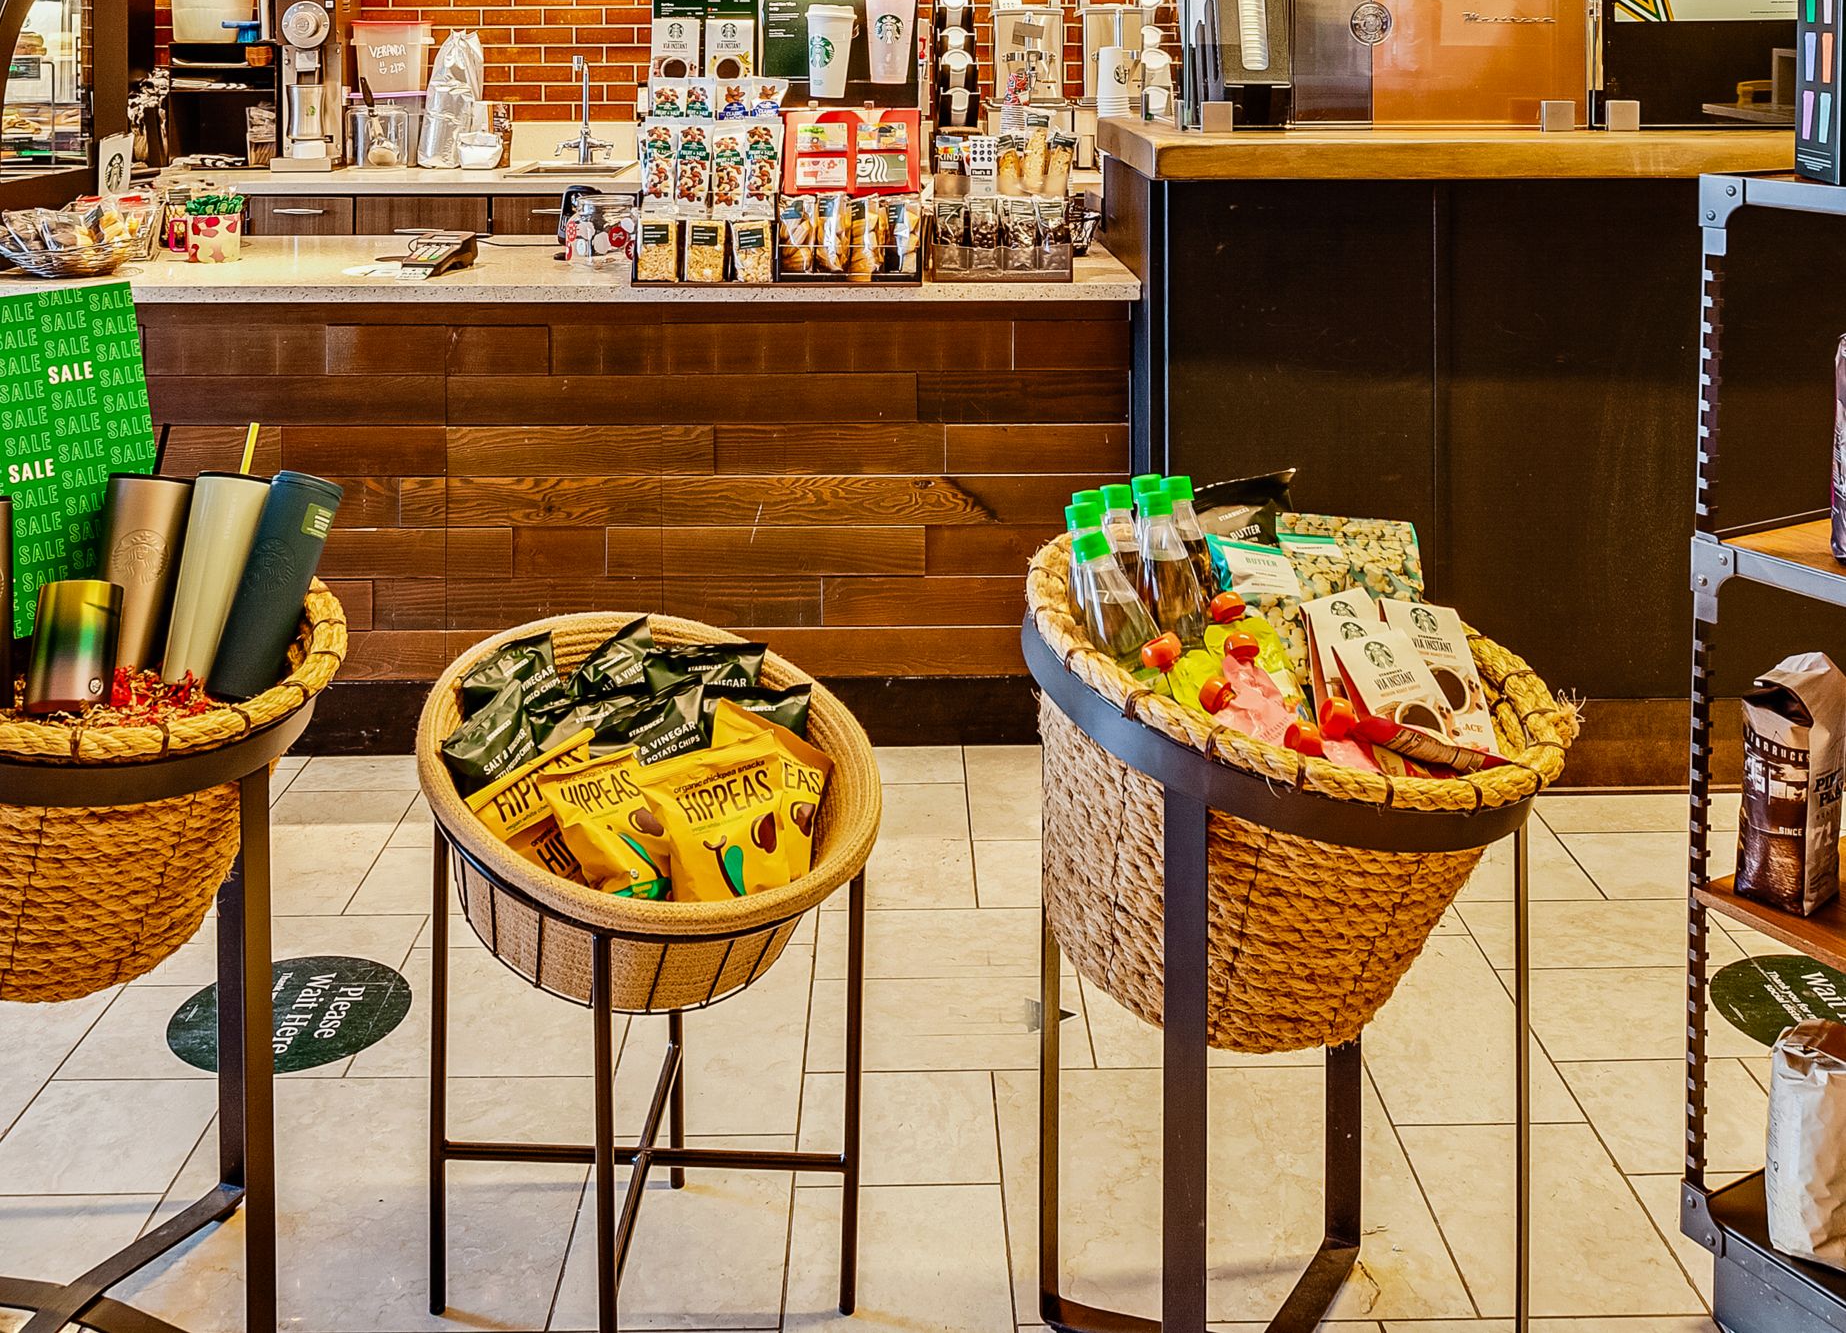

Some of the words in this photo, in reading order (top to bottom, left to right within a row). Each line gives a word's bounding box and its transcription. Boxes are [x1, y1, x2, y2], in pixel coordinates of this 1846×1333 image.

[368, 44, 407, 59] VERANDA
[38, 288, 83, 307] SALE
[89, 289, 134, 312] SALE
[0, 302, 35, 324] ALE
[41, 310, 87, 333] SALE
[92, 313, 138, 337] SALE
[44, 336, 90, 359] SALE
[96, 338, 142, 362] SALE
[48, 361, 94, 384] SALE
[99, 364, 145, 388] SALE
[0, 380, 45, 404] SALE
[51, 387, 98, 411] SALE
[103, 389, 149, 413] SALE
[2, 406, 48, 430] SALE
[54, 412, 101, 437] SALE
[107, 414, 153, 439] SALE
[5, 432, 52, 457] SALE
[58, 438, 105, 463] SALE
[110, 440, 156, 465] SALE
[8, 458, 56, 484] SALE
[62, 464, 109, 489] SALE
[12, 485, 59, 511] SALE
[15, 511, 63, 538] SALE
[1229, 524, 1262, 541] BUTTER
[19, 538, 66, 565] SALE
[1245, 556, 1278, 567] BUTTER
[1411, 638, 1426, 650] VIA
[1424, 641, 1454, 654] INSTANT
[520, 664, 556, 692] VINEGAR
[540, 676, 561, 694] CHIPS
[1374, 677, 1389, 692] VIA
[1388, 672, 1417, 690] INSTANT
[629, 713, 665, 738] STARBUCKS
[640, 745, 649, 756] &
[649, 721, 697, 751] VINEGAR
[646, 744, 678, 765] POTATO
[678, 734, 701, 751] CHIPS
[483, 752, 504, 776] SALT
[674, 777, 702, 794] organic
[702, 768, 737, 787] chickpea
[738, 759, 766, 774] snacks
[561, 769, 641, 815] HIPPEAS
[676, 769, 774, 824] HIPPEAS
[1778, 826, 1803, 836] SINCE
[292, 973, 338, 1011] Wait
[313, 986, 366, 1039] Please
[272, 1013, 314, 1055] Here
